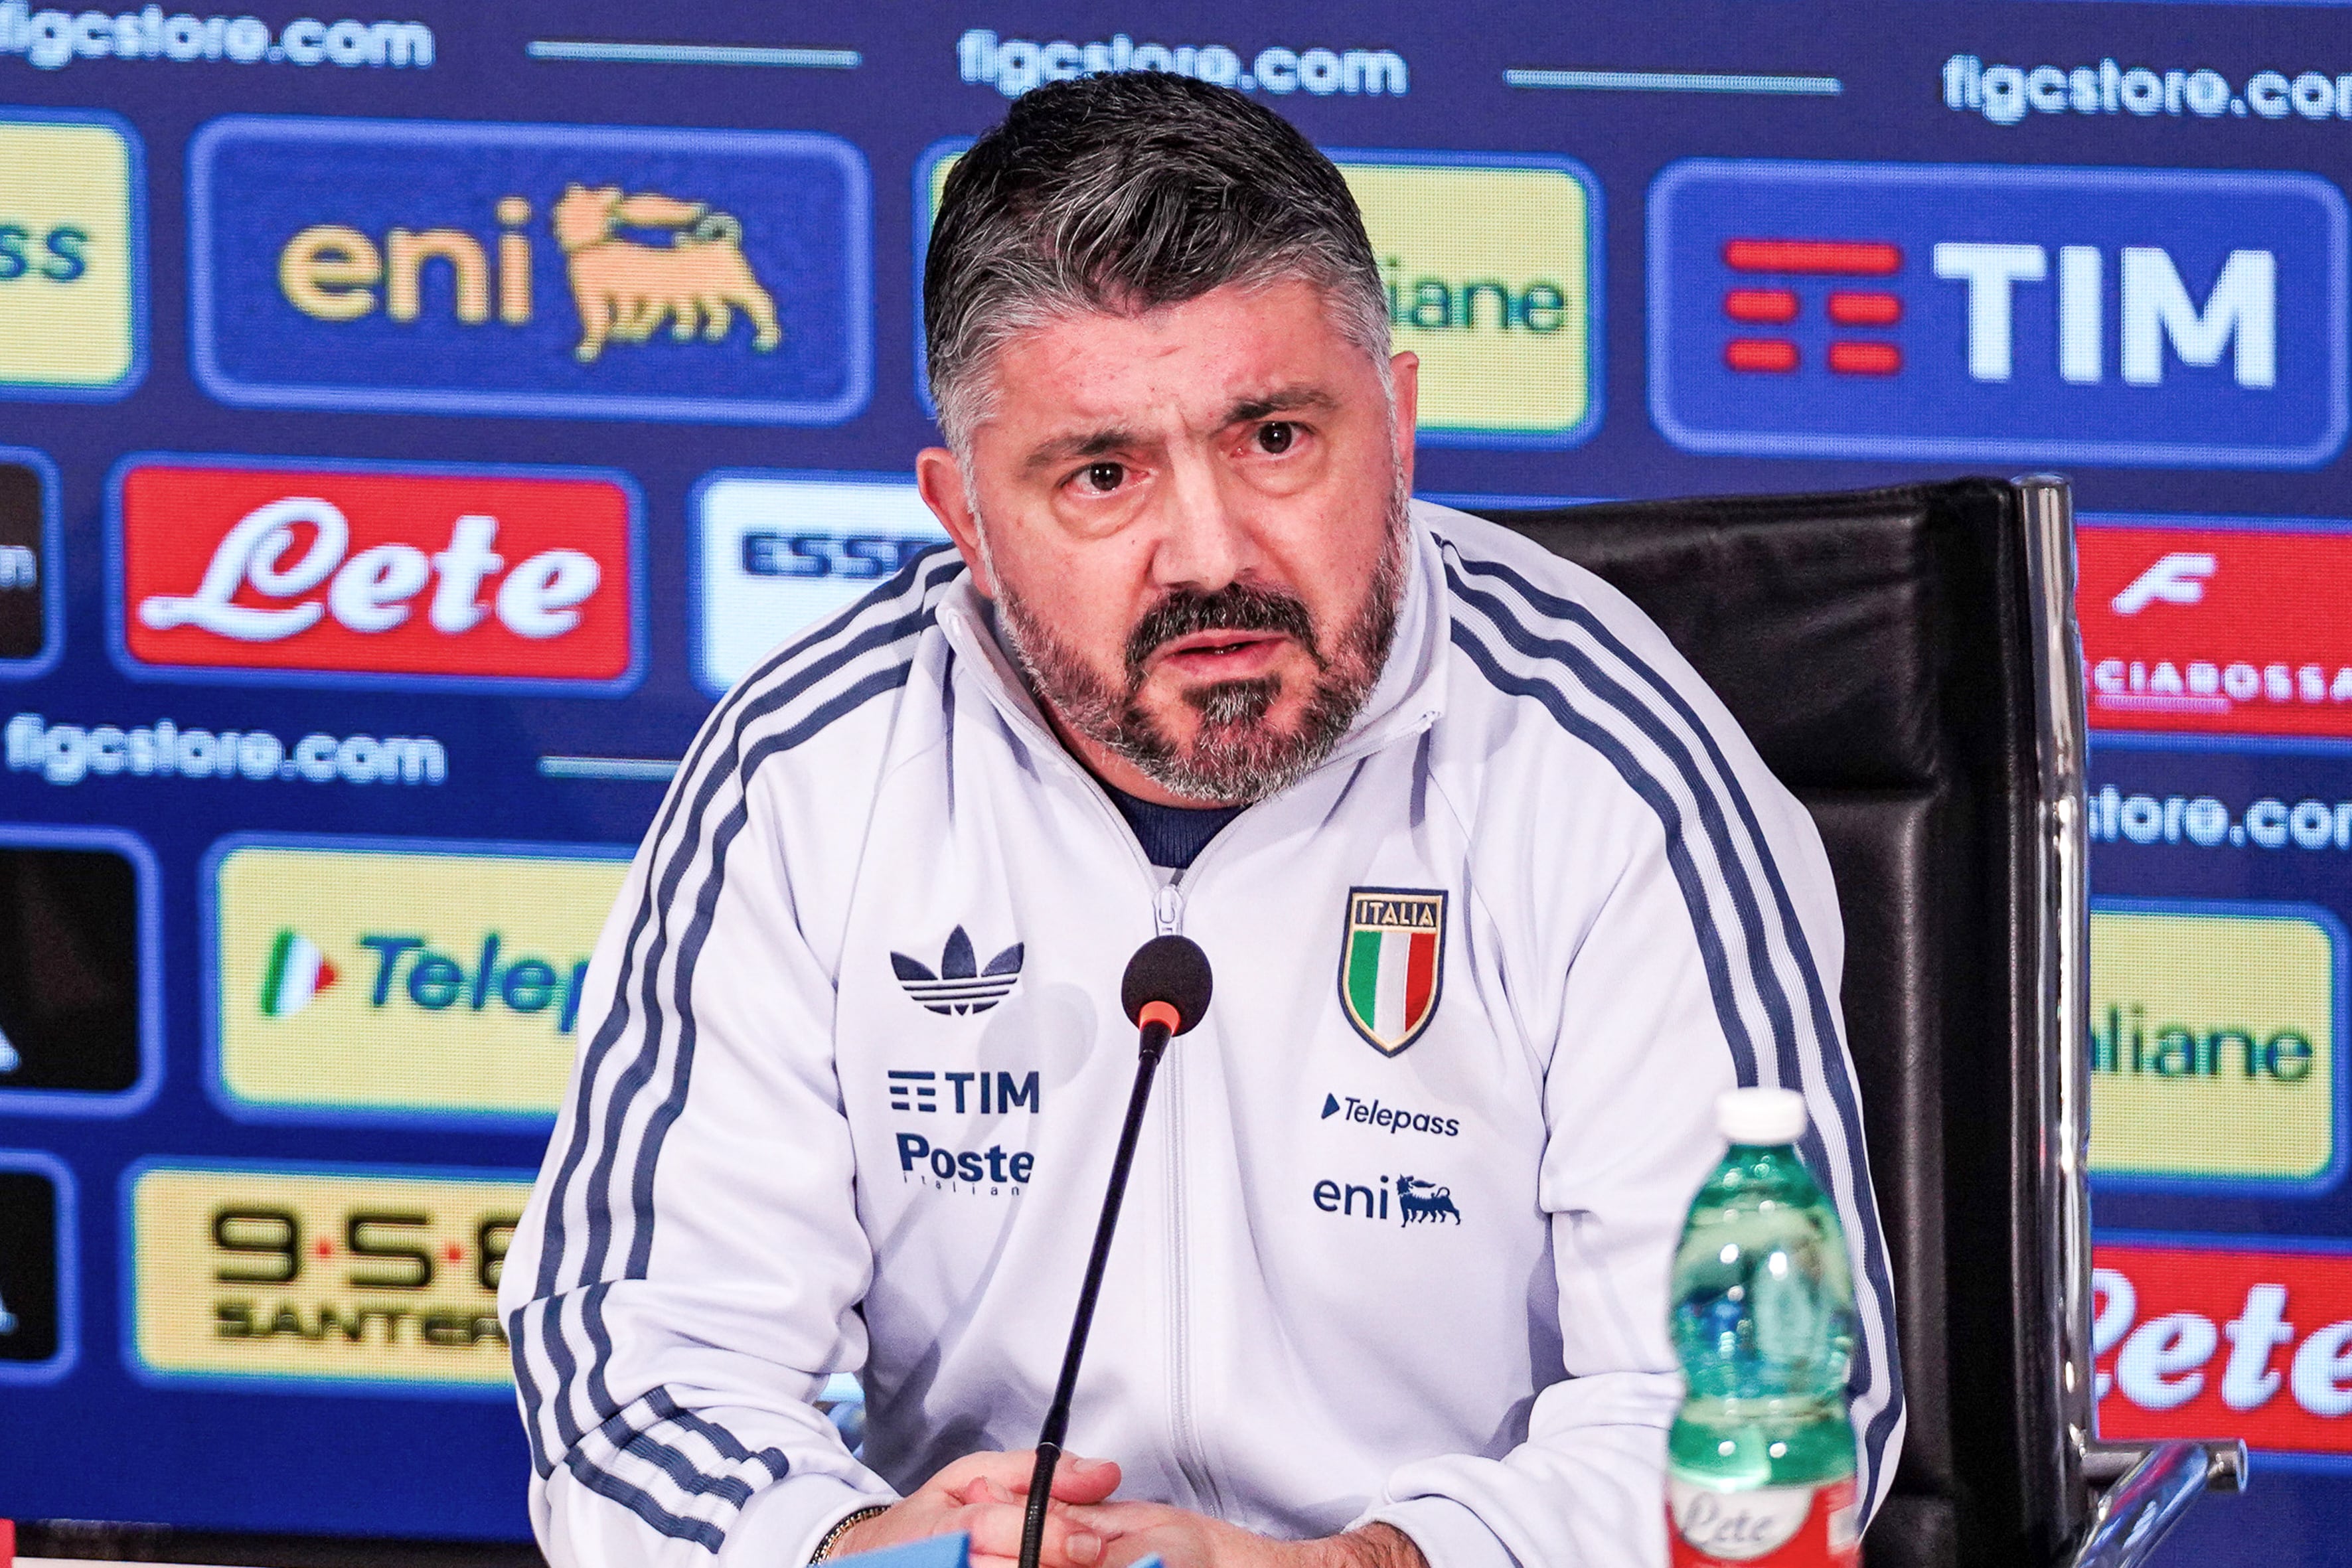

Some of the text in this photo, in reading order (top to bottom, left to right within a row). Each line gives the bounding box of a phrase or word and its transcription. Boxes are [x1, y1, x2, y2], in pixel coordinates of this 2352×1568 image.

[1942, 53, 2352, 125] figcstore.co
[277, 195, 534, 325] eni
[1932, 242, 2277, 390] TIM
[138, 495, 603, 643] Lete
[2088, 783, 2352, 851] tore.co
[1360, 901, 1435, 927] ITALIA
[945, 1071, 1040, 1114] TIM
[1344, 1095, 1460, 1137] Telepass
[896, 1132, 1034, 1184] Poste
[1313, 1175, 1390, 1220] eni
[2092, 1267, 2352, 1418] ete
